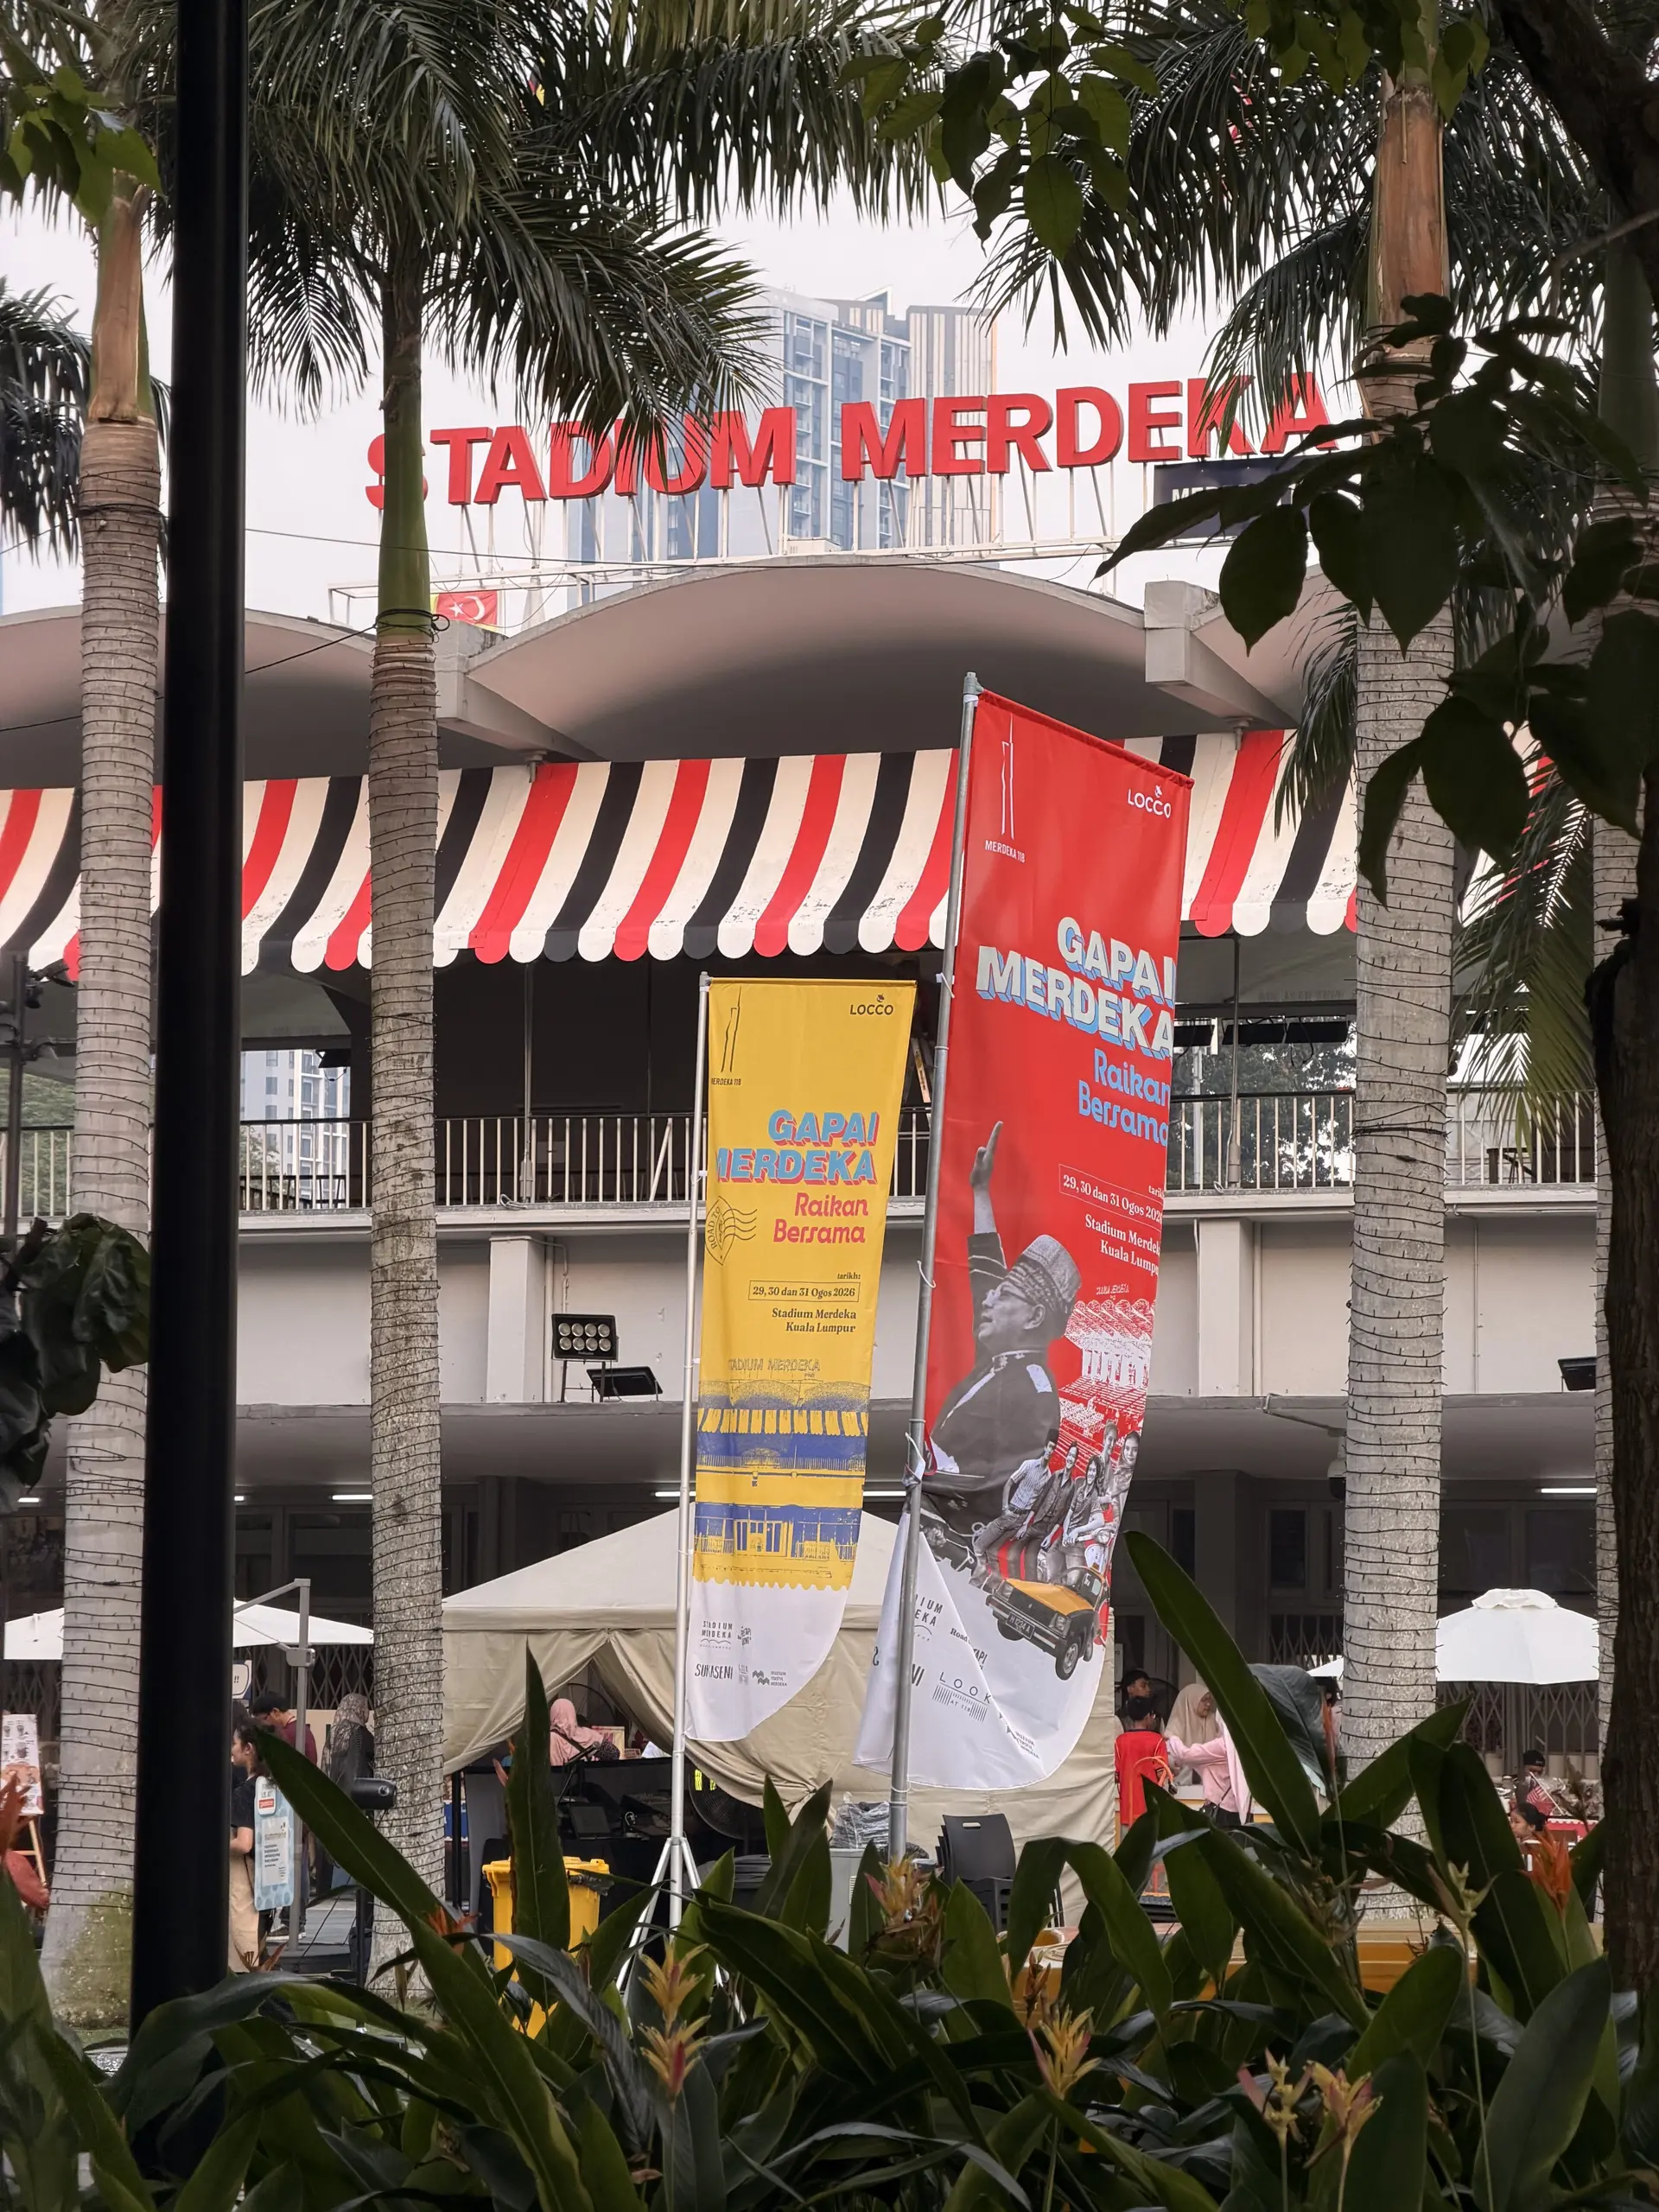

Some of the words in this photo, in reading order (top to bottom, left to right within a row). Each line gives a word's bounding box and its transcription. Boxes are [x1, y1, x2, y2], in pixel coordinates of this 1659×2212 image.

[842, 372, 1338, 481] MERDEKA
[1128, 788, 1172, 818] LOCCO
[985, 840, 1017, 860] MERDEKA
[1017, 852, 1026, 863] 118
[1057, 917, 1176, 1009] GAPAI
[850, 1004, 893, 1015] LOCCO
[976, 945, 1173, 1060] MERDEKA
[768, 1109, 880, 1147] GAPAI
[795, 1192, 868, 1217] Raikan
[1063, 1174, 1079, 1193] 29,
[1080, 1180, 1091, 1195] 30
[1092, 1186, 1109, 1203] dan
[1110, 1193, 1120, 1207] 31
[1122, 1198, 1144, 1216] Ogos
[708, 1220, 717, 1249] ROAD
[773, 1218, 866, 1243] Bersama
[1084, 1213, 1127, 1241] Stadium
[1128, 1230, 1160, 1257] Merdek
[1100, 1240, 1129, 1262] Kuala
[1131, 1255, 1159, 1276] Lumpu
[753, 1287, 767, 1297] 29,
[768, 1287, 779, 1296] 30
[781, 1287, 798, 1296] dan
[799, 1287, 809, 1296] 31
[810, 1287, 832, 1300] Ogos
[833, 1287, 855, 1297] 2026
[772, 1307, 813, 1319] Stadium
[815, 1308, 856, 1319] Merdeka
[785, 1322, 815, 1332] Kuala
[817, 1322, 855, 1335] Lumpur
[767, 1358, 820, 1371] MERDEKA
[939, 1671, 991, 1704] LOOK
